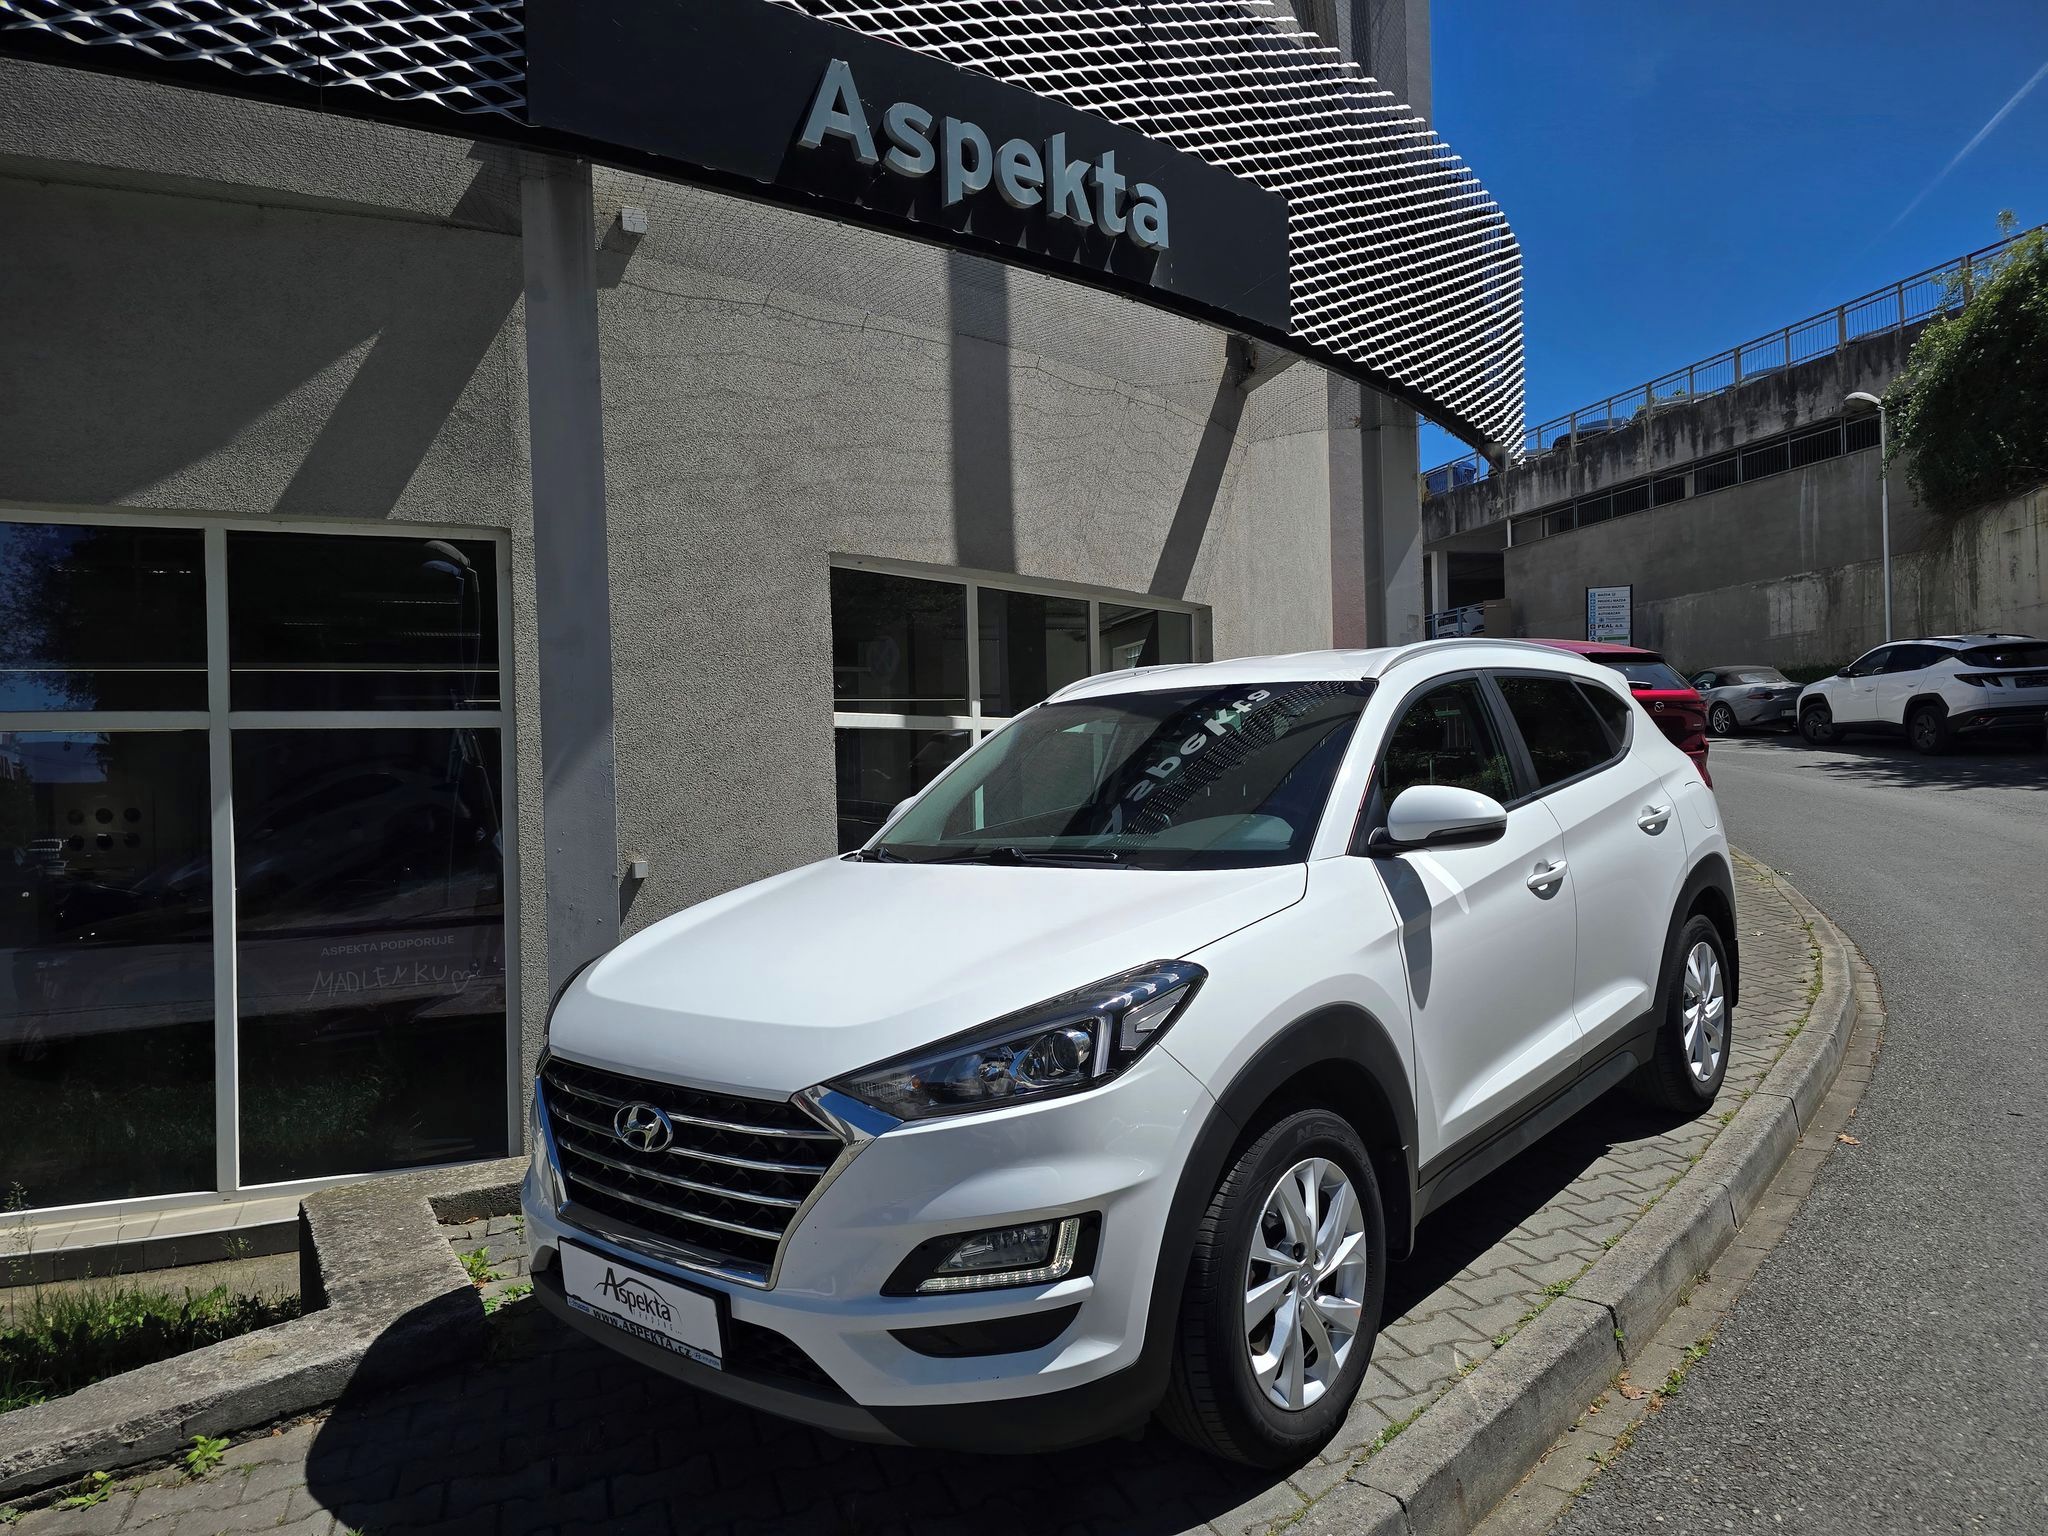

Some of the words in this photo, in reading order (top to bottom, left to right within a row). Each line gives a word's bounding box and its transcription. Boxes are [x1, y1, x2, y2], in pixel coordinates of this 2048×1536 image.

[798, 57, 1170, 250] Aspekta
[321, 943, 378, 957] ASPEKTA
[380, 935, 455, 951] PODPORUJE
[602, 1266, 672, 1322] Aspekta
